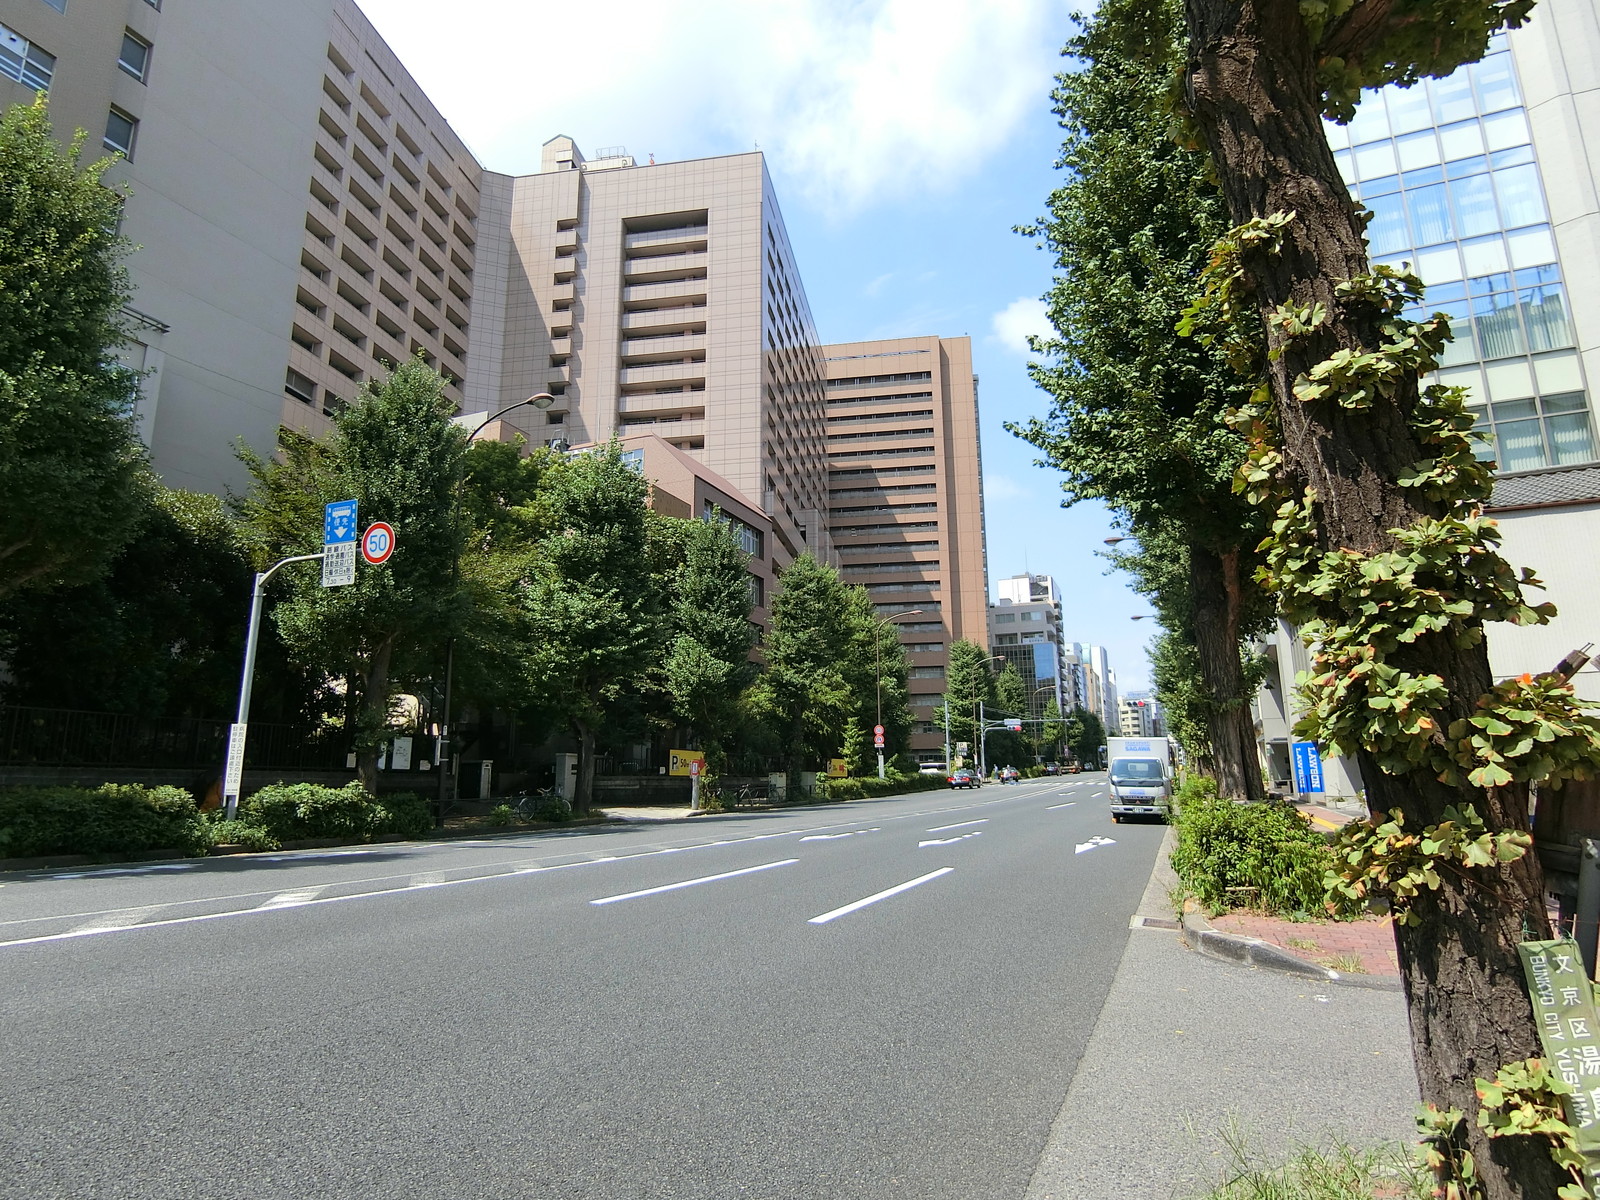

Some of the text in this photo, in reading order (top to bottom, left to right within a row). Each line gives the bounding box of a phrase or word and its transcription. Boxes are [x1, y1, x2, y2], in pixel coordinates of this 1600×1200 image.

[333, 517, 349, 526] 優先
[369, 533, 387, 553] 50
[671, 755, 678, 770] P
[1307, 746, 1321, 789] LAWSON
[1529, 954, 1555, 1007] BUNKYO
[1543, 1012, 1565, 1041] CITY
